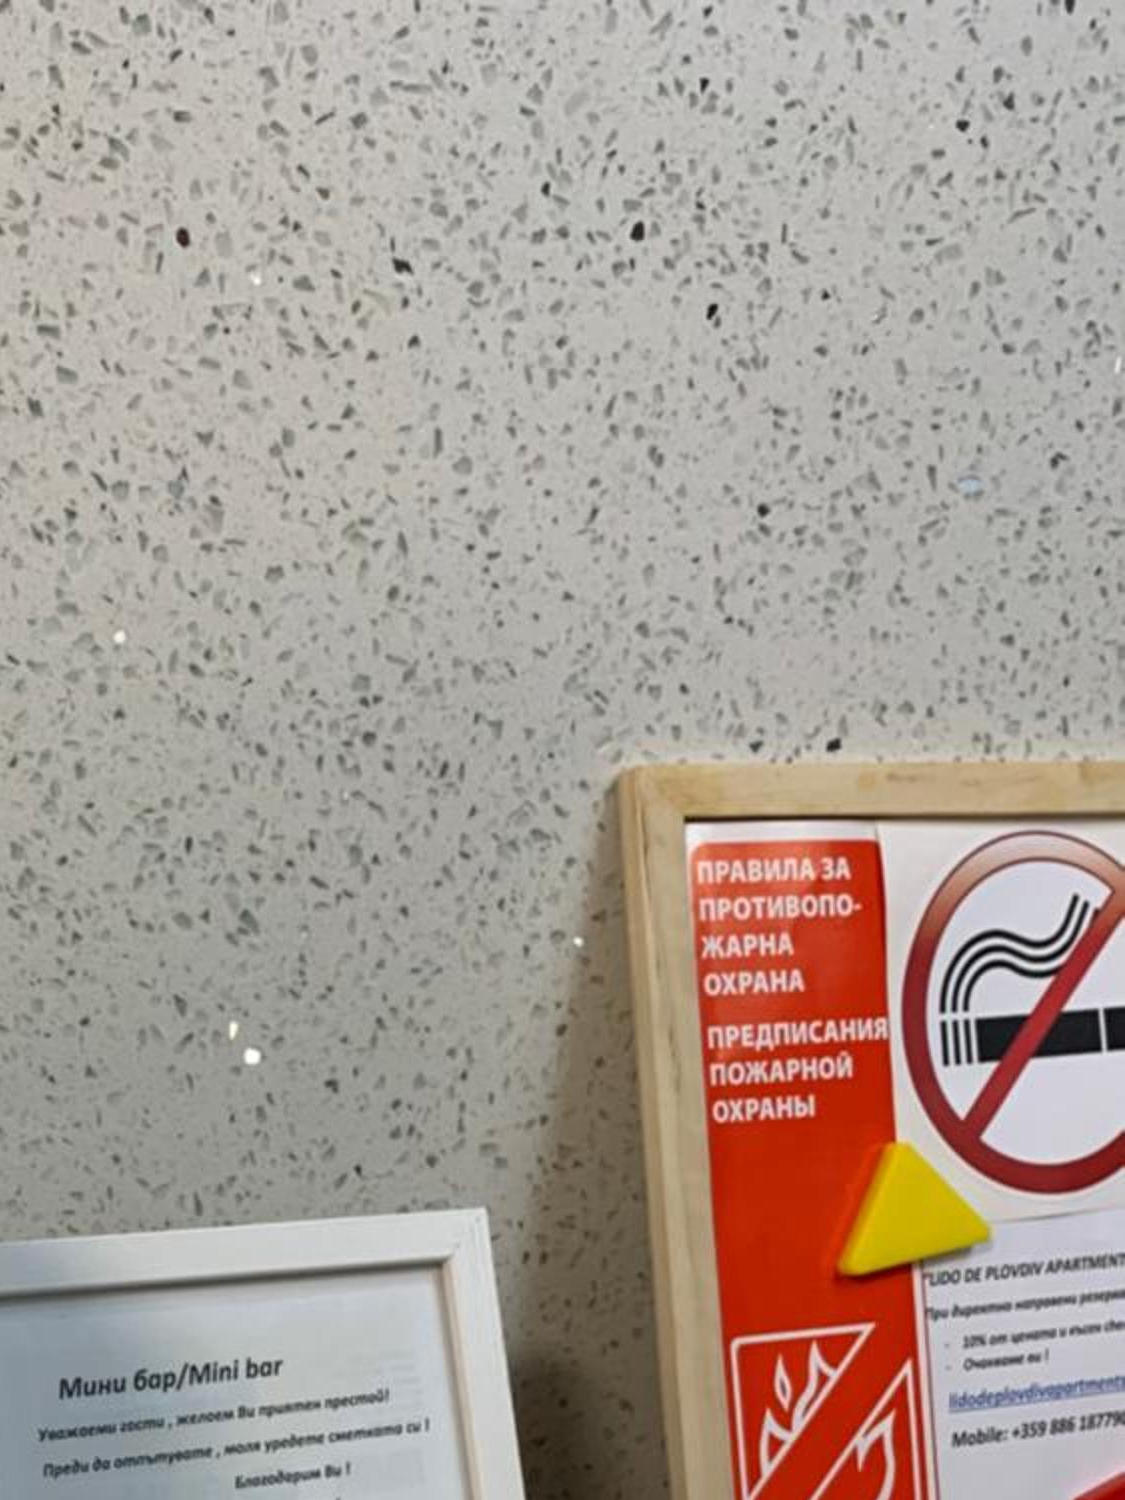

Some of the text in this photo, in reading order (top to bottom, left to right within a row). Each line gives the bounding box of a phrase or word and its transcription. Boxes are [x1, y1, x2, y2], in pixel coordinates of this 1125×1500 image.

[696, 856, 851, 885] ПРАВИЛА ЗА
[699, 894, 862, 922] ПРОТИВОПО-
[701, 932, 794, 959] ЖАРНА
[704, 969, 806, 997] ОХРАНА
[707, 1016, 889, 1053] ПРЕДПИСАНИЯ
[710, 1055, 854, 1086] ПОЖАРНОЙ
[712, 1095, 816, 1123] ОХРАНЫ
[964, 1266, 982, 1283] DE
[985, 1261, 1044, 1281] PLOVDIV
[58, 1358, 283, 1400] Мини бар/Mini bar
[37, 1423, 117, 1442] Уважаеми
[120, 1416, 166, 1434] гости
[237, 1405, 255, 1418] Ви
[258, 1400, 321, 1418] приятен
[324, 1388, 390, 1411] престой!
[951, 1428, 1009, 1448] Mobile:
[1011, 1420, 1047, 1439] +359
[43, 1421, 421, 1479] Преди да отпътувате моля уредете сметката си
[235, 1464, 342, 1489] Благодарим Ви
